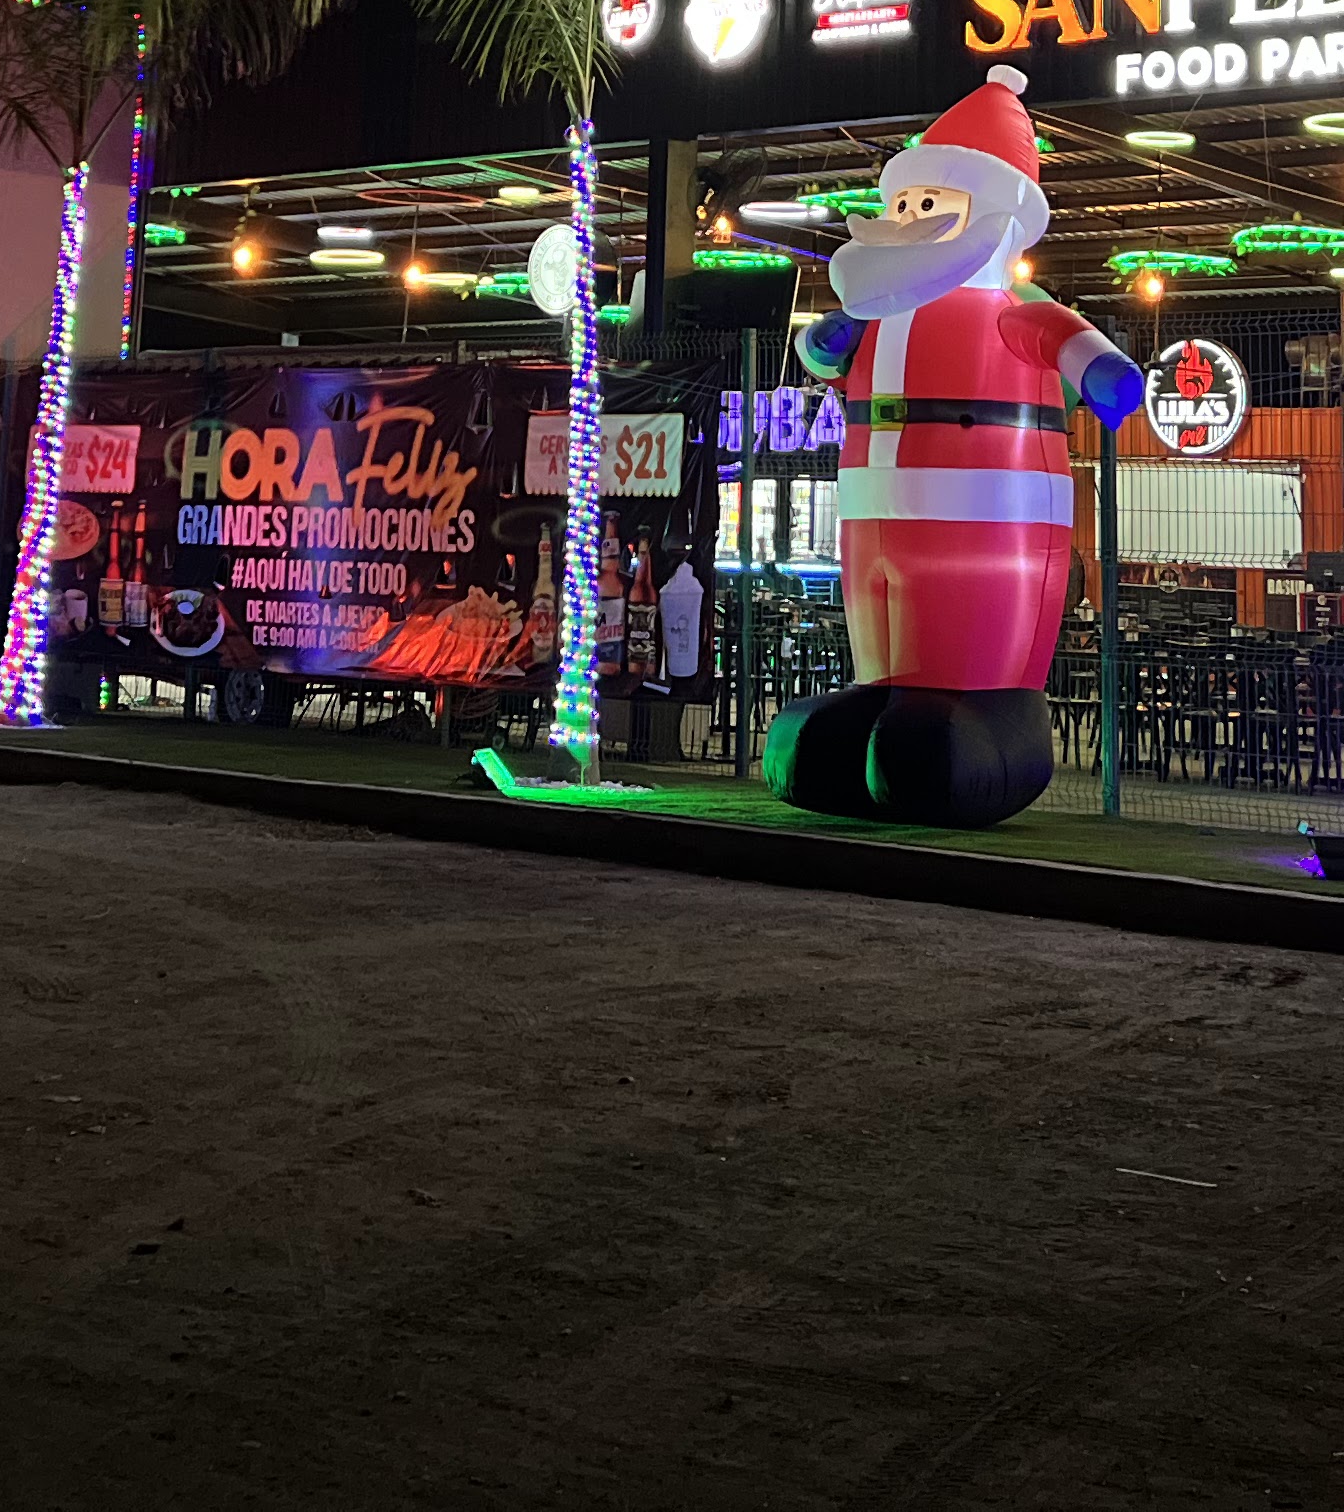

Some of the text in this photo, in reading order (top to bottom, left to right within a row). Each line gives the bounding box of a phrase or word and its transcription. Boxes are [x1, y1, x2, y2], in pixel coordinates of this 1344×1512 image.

[1115, 47, 1249, 95] FOOD
[85, 434, 131, 484] $24
[179, 427, 344, 502] HORA
[613, 424, 668, 486] $21
[177, 504, 475, 553] GRANDES PROMOCIONES
[231, 551, 407, 596] #AQUÍ HAY DE TODO
[246, 599, 264, 623] DE
[265, 600, 321, 626] MARTES
[322, 603, 331, 627] A
[252, 625, 268, 646] DE
[269, 626, 296, 648] 9:00
[296, 628, 317, 649] AM
[318, 630, 327, 649] A
